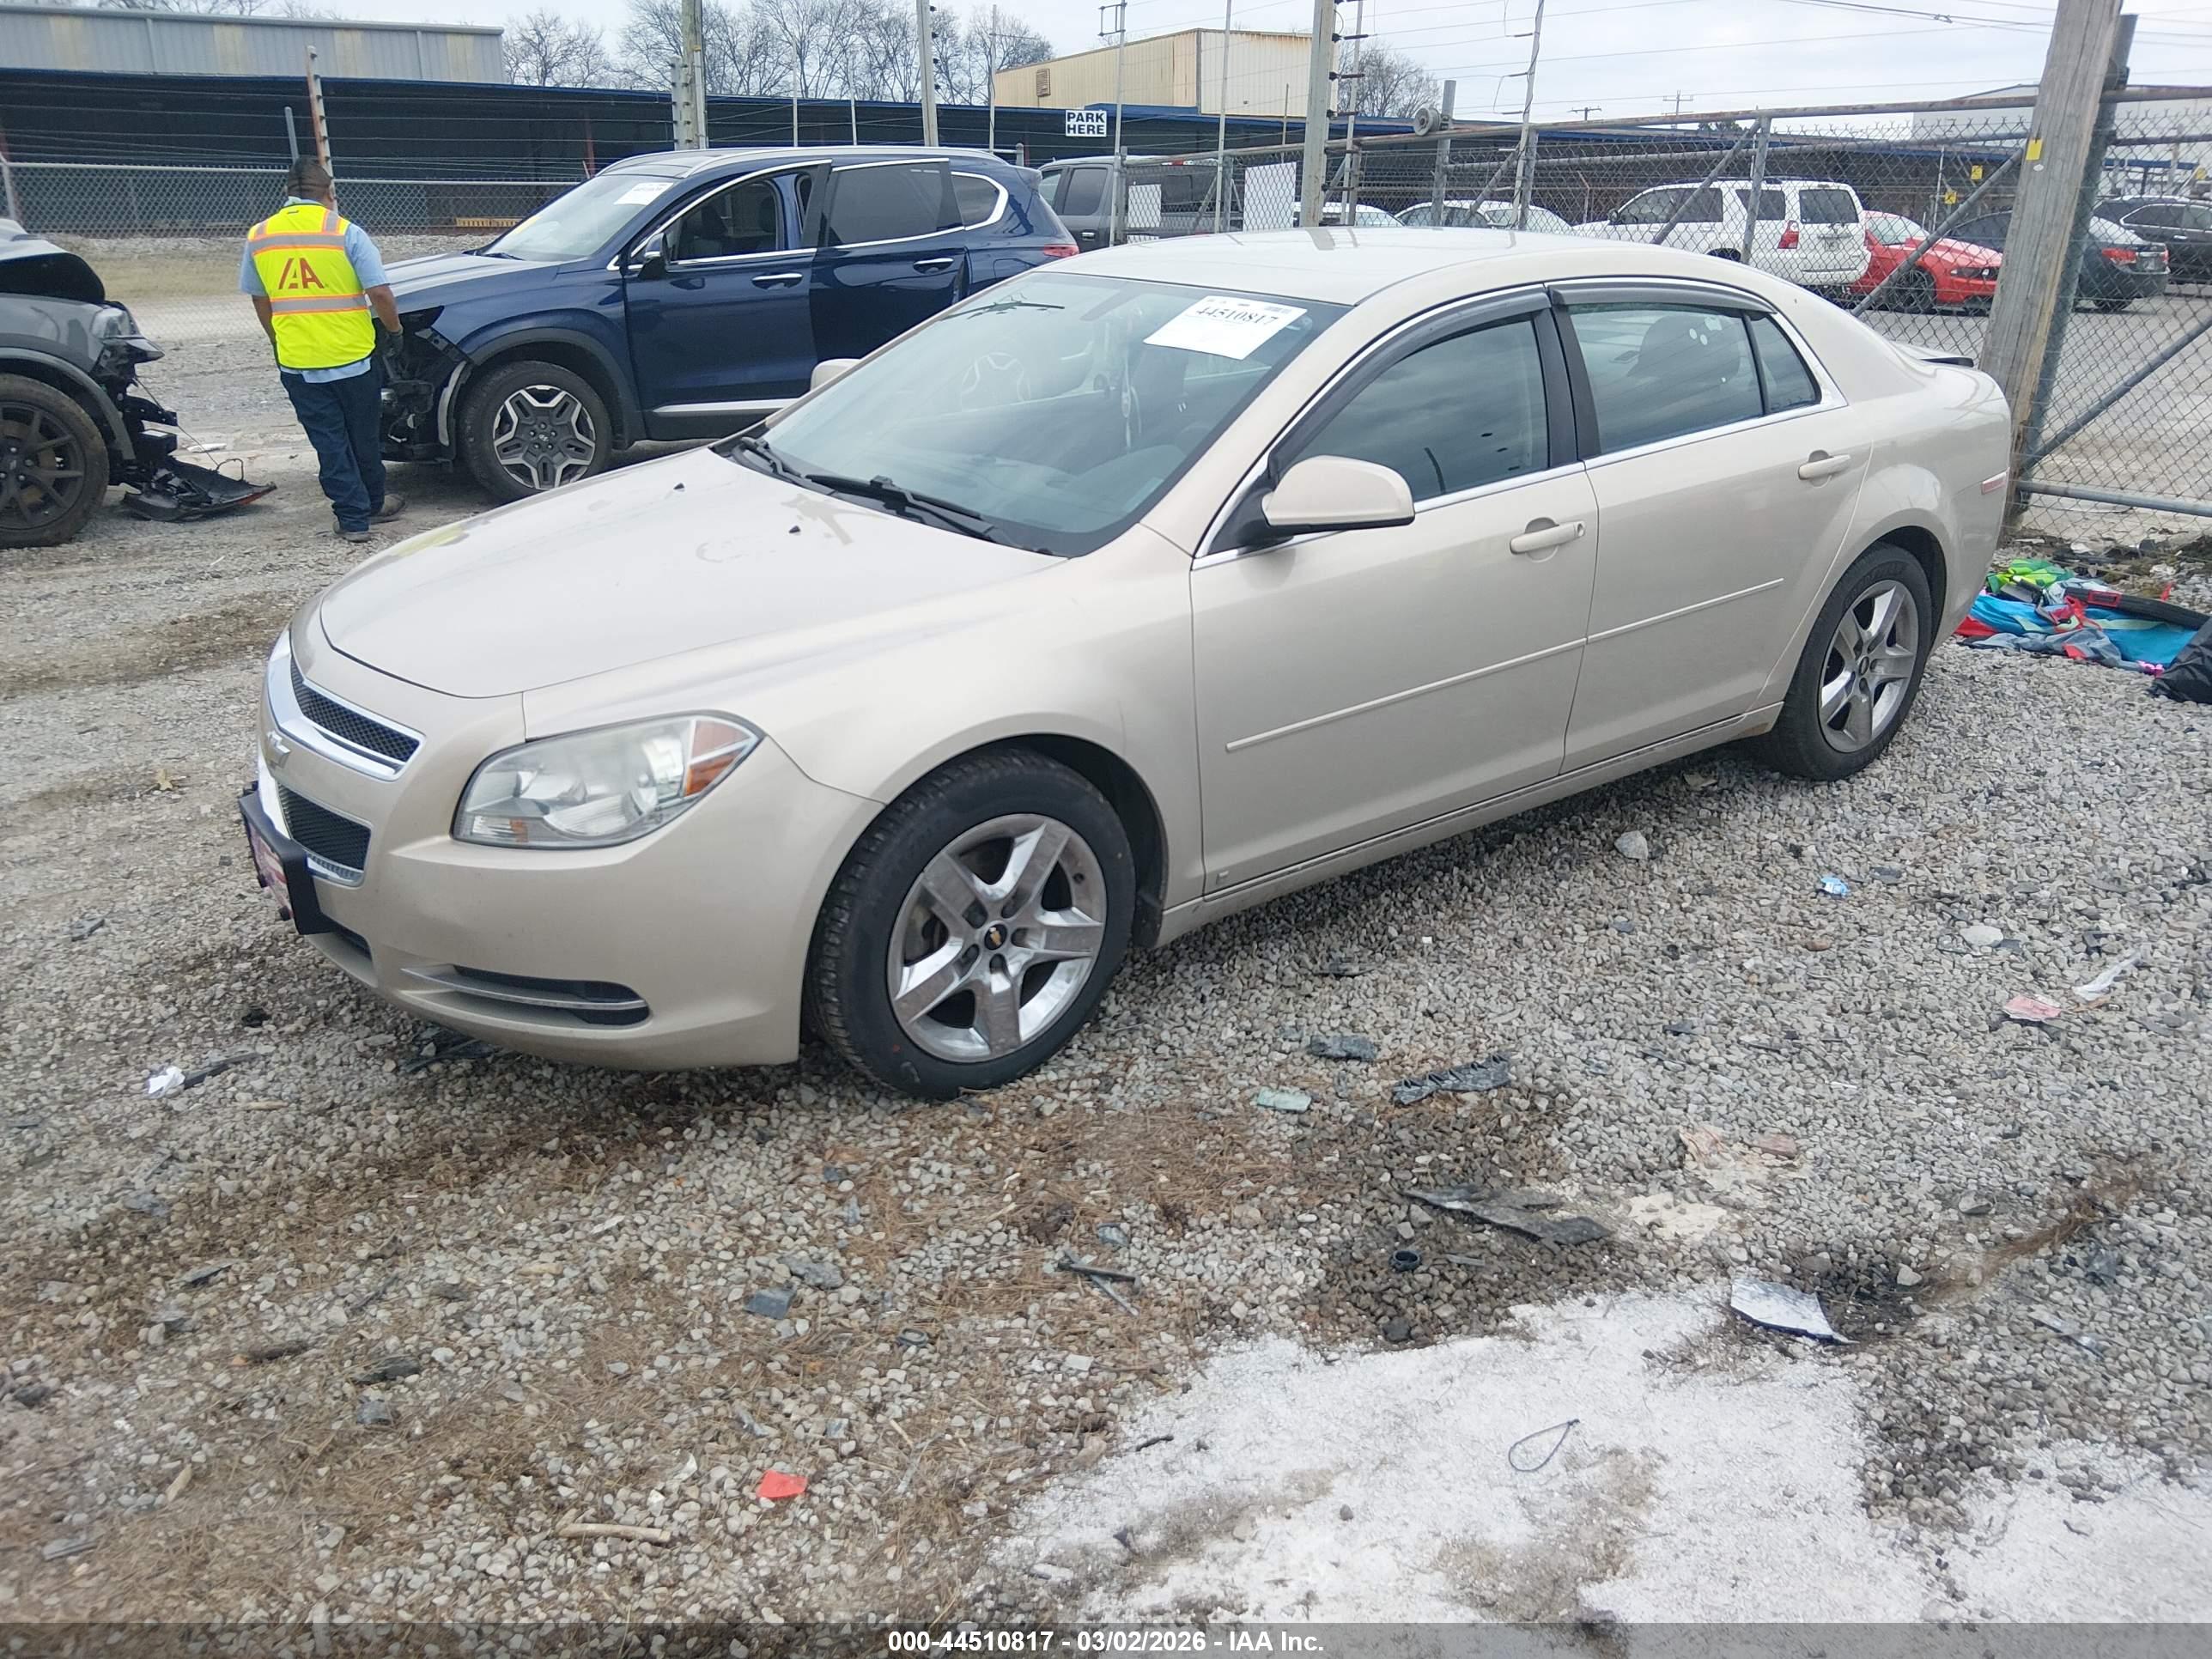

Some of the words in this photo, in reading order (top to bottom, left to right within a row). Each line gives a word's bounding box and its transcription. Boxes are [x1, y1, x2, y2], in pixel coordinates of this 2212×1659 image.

[1066, 112, 1105, 123] PARK
[1066, 124, 1105, 135] HERE
[1196, 307, 1278, 324] 44510817
